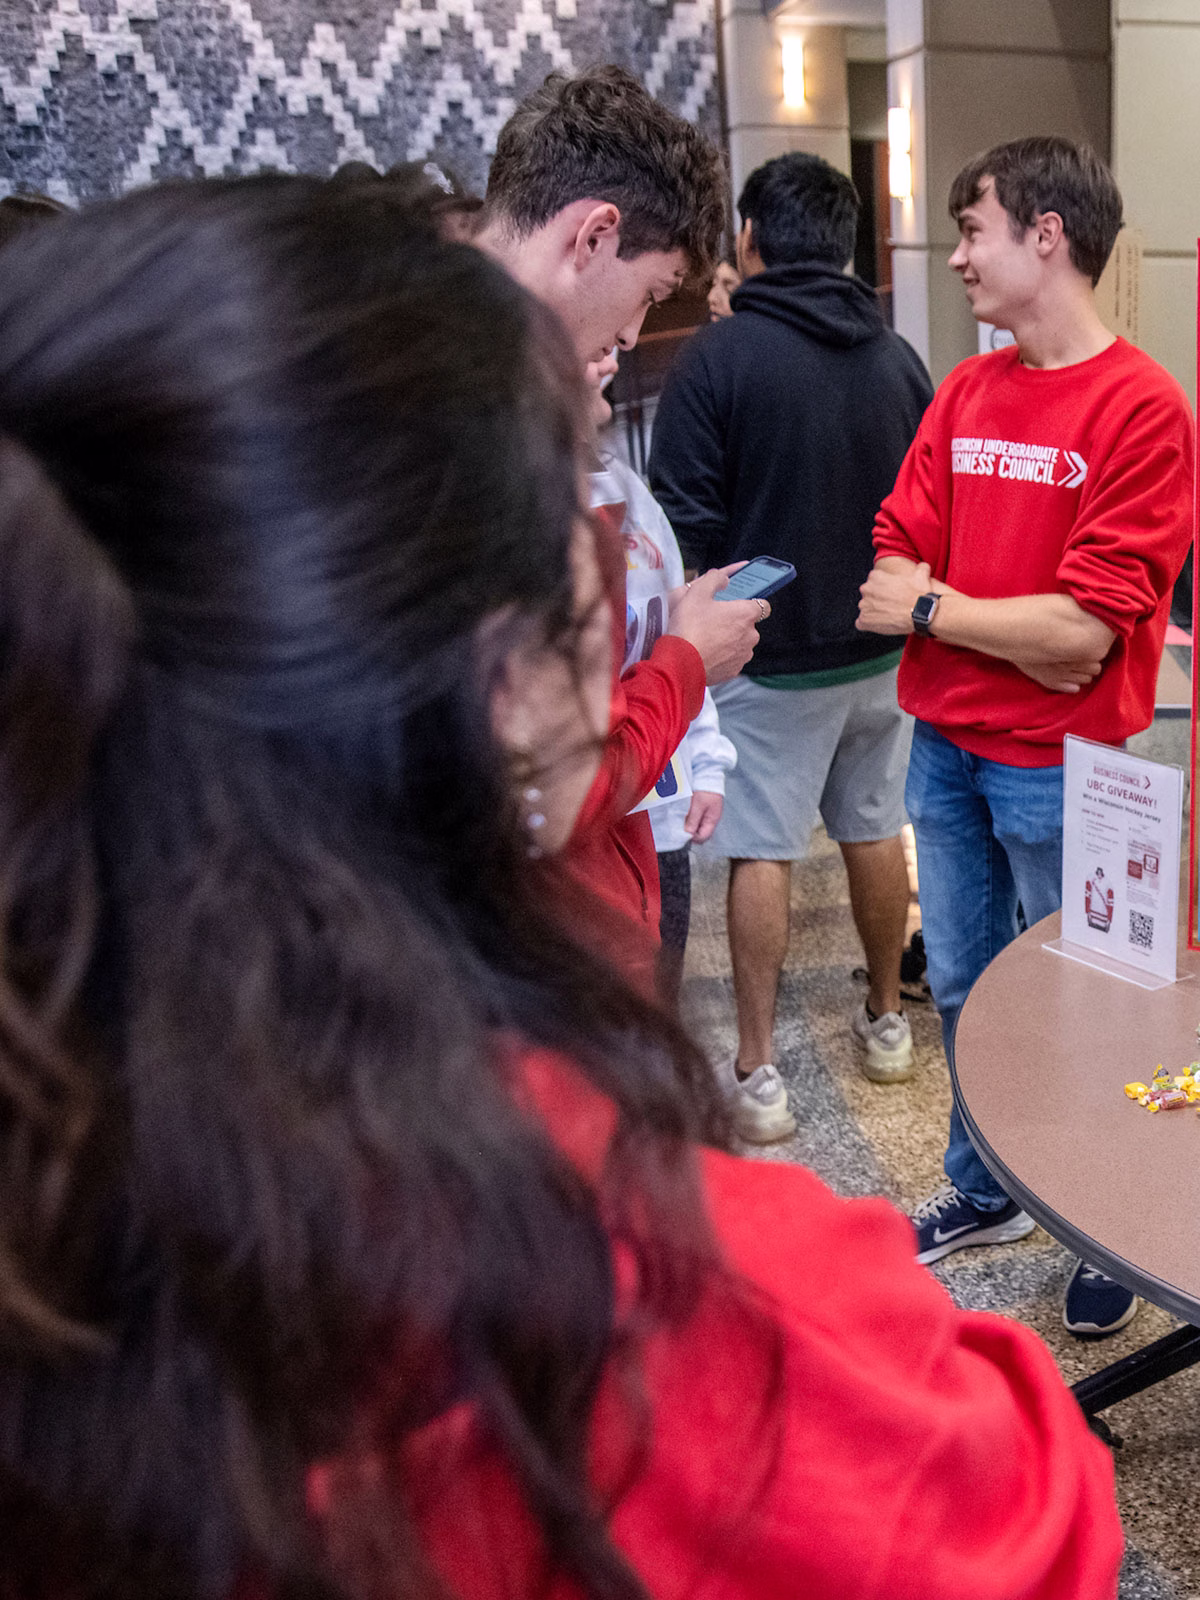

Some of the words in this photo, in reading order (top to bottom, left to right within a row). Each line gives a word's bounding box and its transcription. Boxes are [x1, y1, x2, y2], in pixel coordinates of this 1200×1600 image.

[983, 438, 1060, 464] UNDERGRADUATE
[998, 456, 1055, 485] COUNCIL
[1094, 766, 1118, 780] BUSINESS
[1119, 773, 1141, 788] COUNCIL
[1087, 779, 1105, 792] UBC
[1107, 785, 1157, 808] GIVEAWAY!
